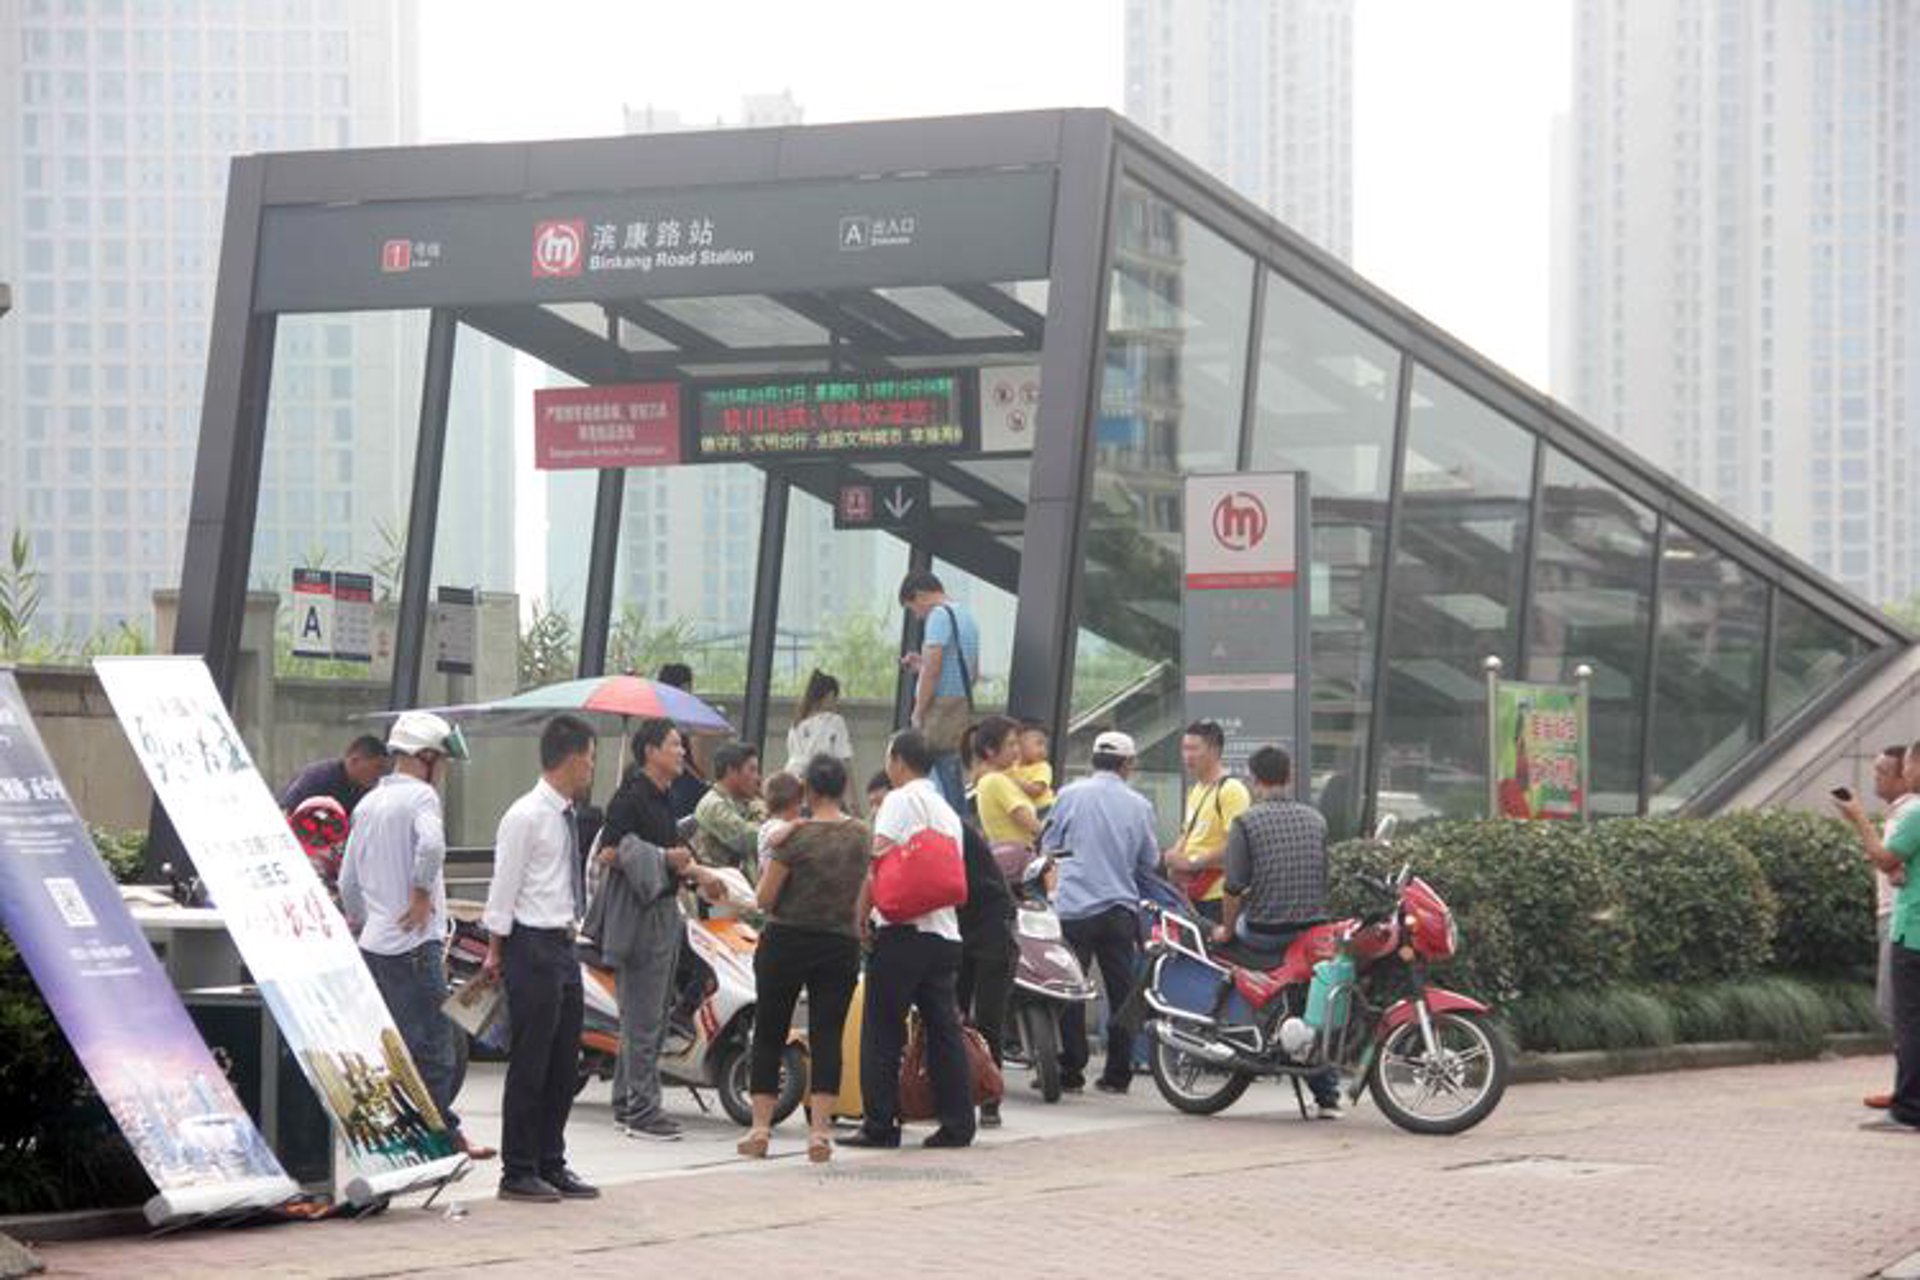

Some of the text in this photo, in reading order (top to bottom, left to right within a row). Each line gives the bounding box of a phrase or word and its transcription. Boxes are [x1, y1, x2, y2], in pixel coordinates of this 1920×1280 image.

[591, 217, 715, 250] 滨康路站
[844, 223, 862, 244] A
[588, 248, 755, 272] Binkang Road Station
[302, 605, 321, 638] A
